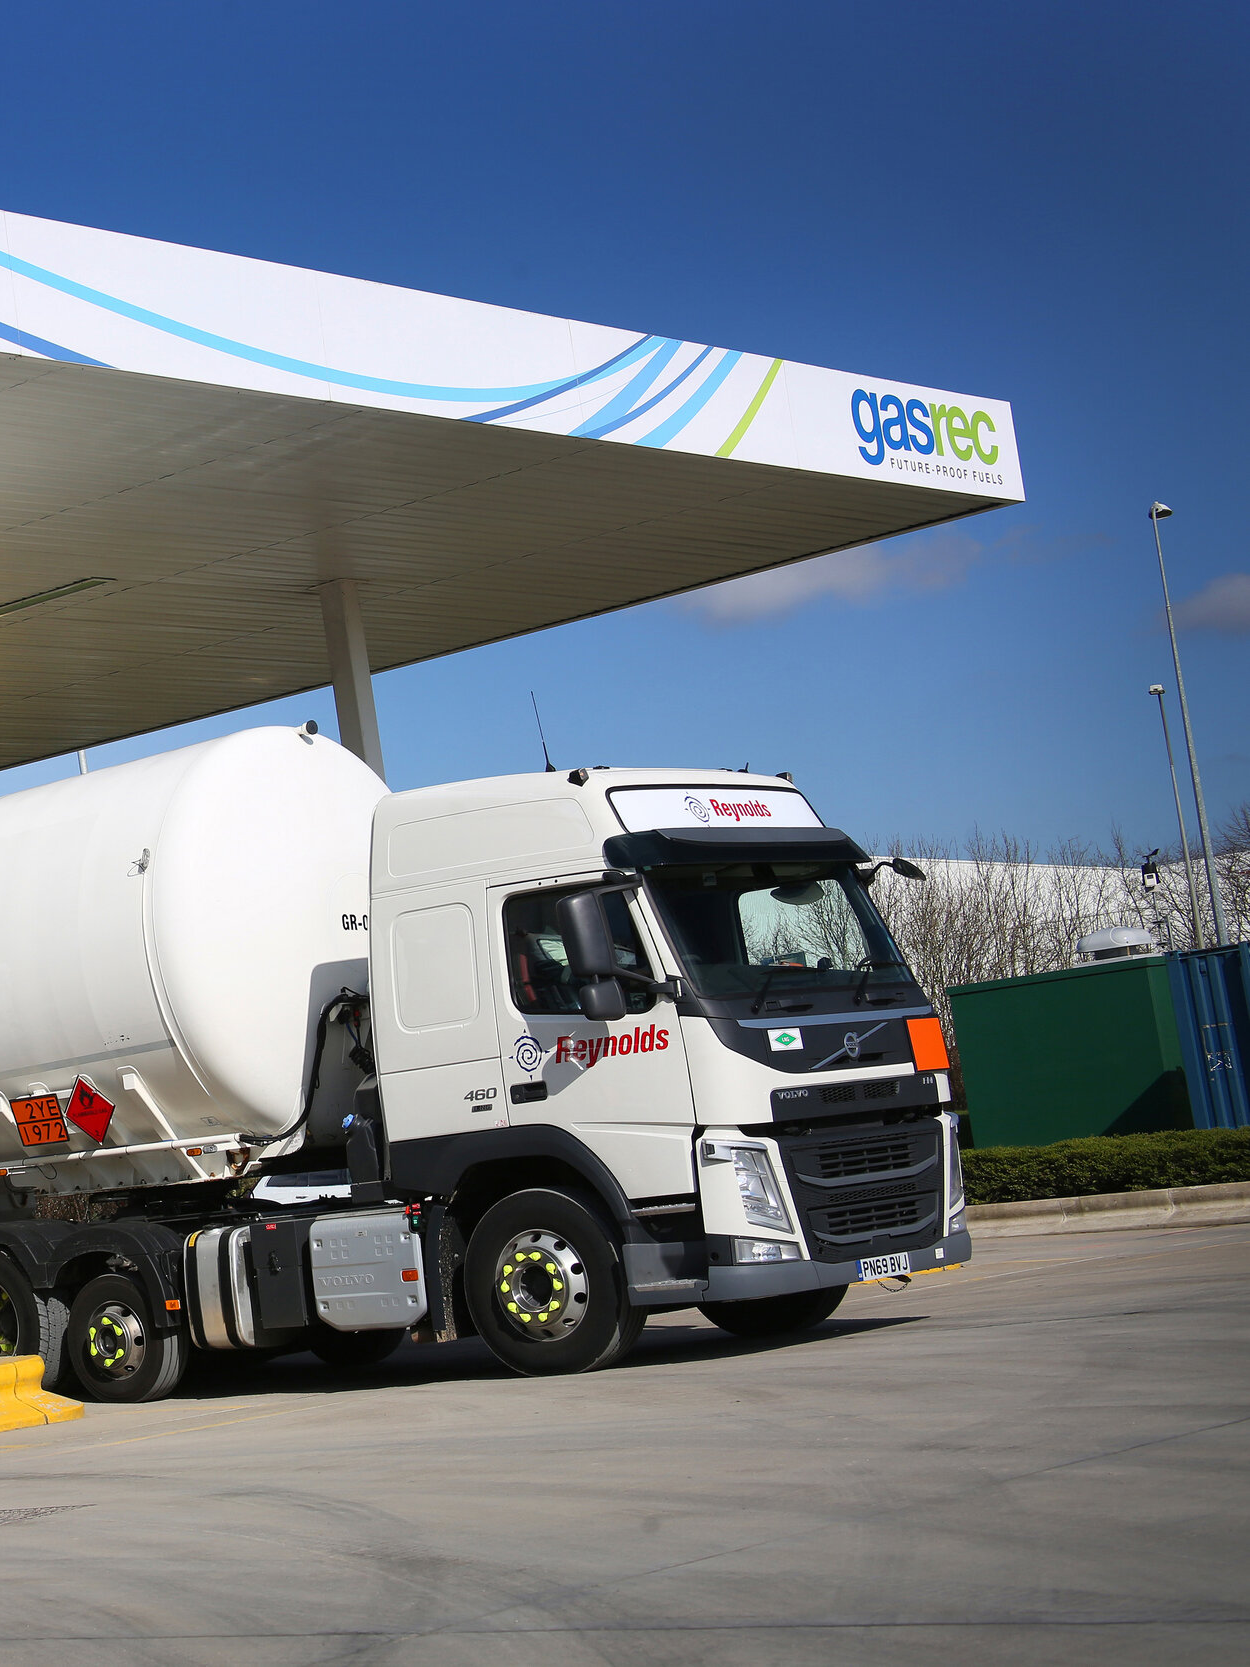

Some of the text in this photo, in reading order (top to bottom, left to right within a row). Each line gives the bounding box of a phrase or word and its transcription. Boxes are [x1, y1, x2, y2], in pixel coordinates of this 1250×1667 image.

[851, 388, 999, 465] gasrec
[890, 457, 1004, 485] FUTURE-PROOF FUELS
[709, 798, 772, 822] Reynolds
[555, 1024, 670, 1068] Reynolds
[463, 1087, 498, 1102] 460
[776, 1089, 809, 1100] VOLVO
[25, 1099, 60, 1119] 2YE
[23, 1121, 66, 1143] 1972
[862, 1254, 908, 1278] PN69 BVJ
[318, 1273, 375, 1288] VOLVO
